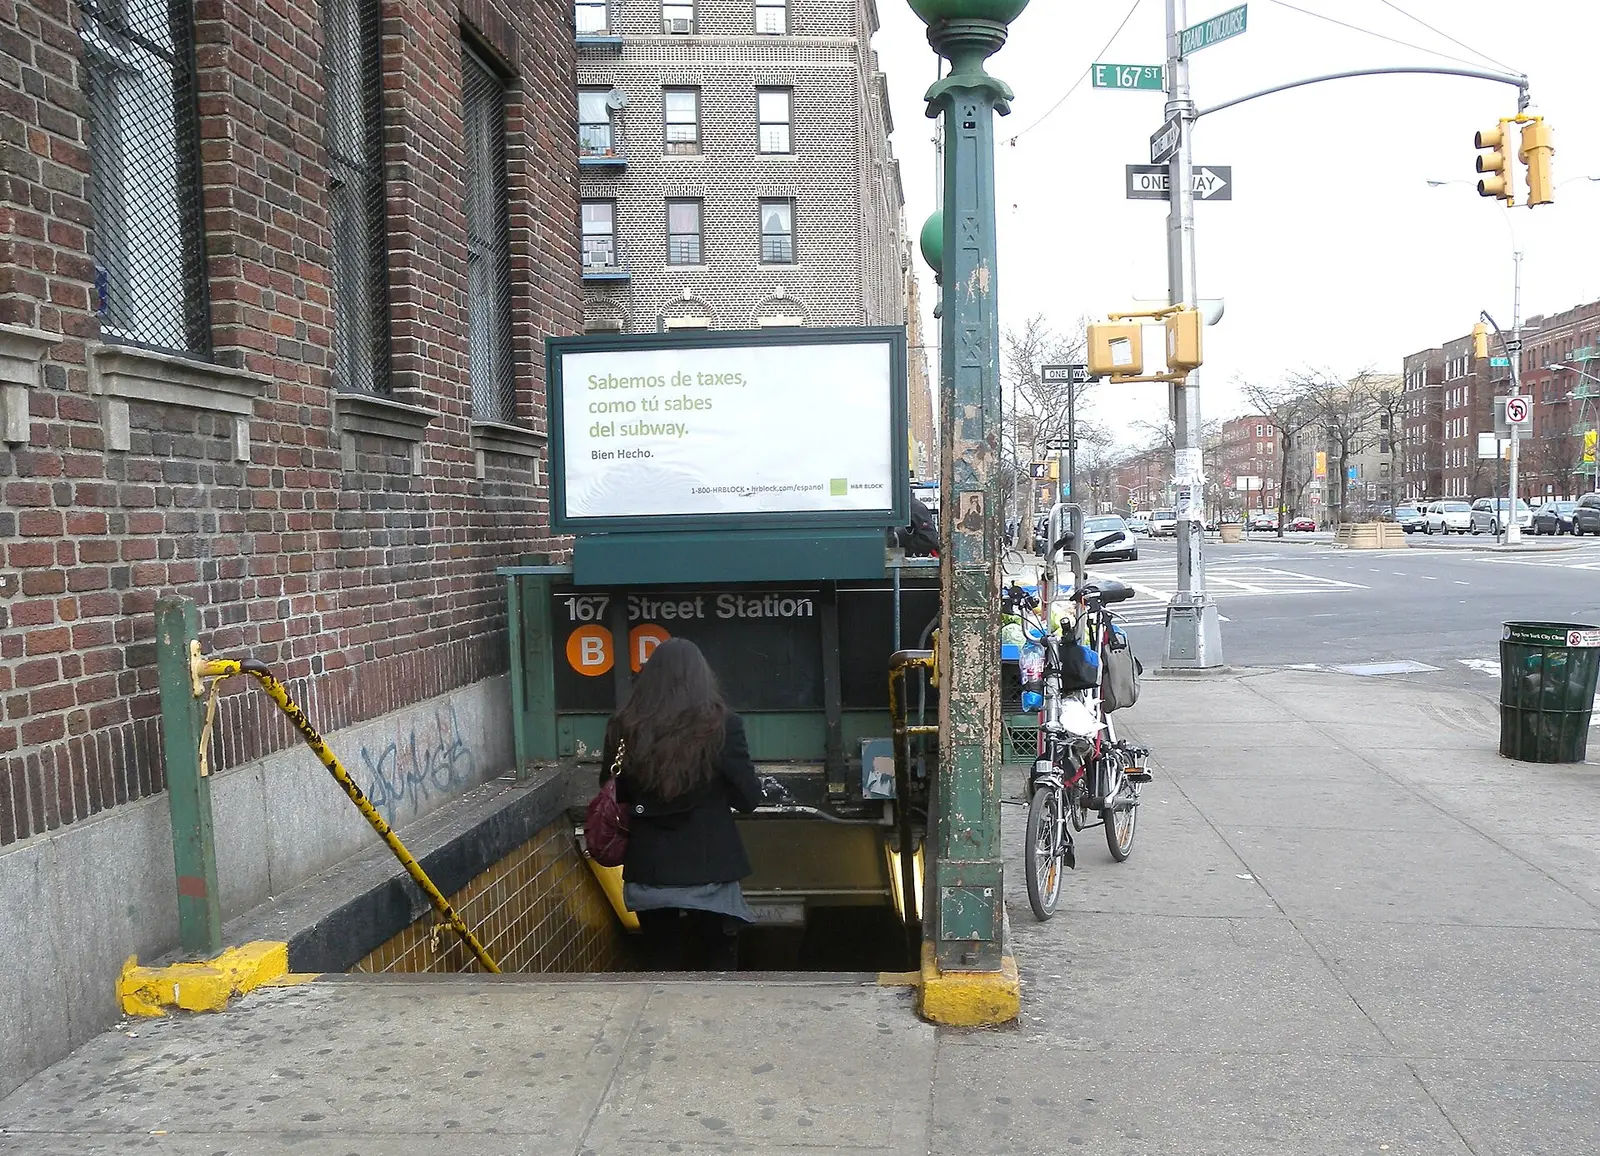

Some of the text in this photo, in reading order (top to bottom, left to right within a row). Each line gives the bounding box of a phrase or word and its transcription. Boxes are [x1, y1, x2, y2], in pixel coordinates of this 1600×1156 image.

[1183, 9, 1244, 53] GRAND CONCOURSE
[1096, 65, 1159, 87] E 167 ST
[1141, 176, 1216, 191] ONE AY
[588, 371, 747, 390] Sabemos de taxes,
[589, 395, 713, 413] como tú sabes
[589, 420, 689, 438] del subway.
[591, 447, 654, 460] Bien Hecho.
[691, 485, 745, 495] 1-800-HRBLOCK
[564, 594, 812, 620] 167 Street Station
[1541, 633, 1551, 641] City
[581, 636, 605, 665] B
